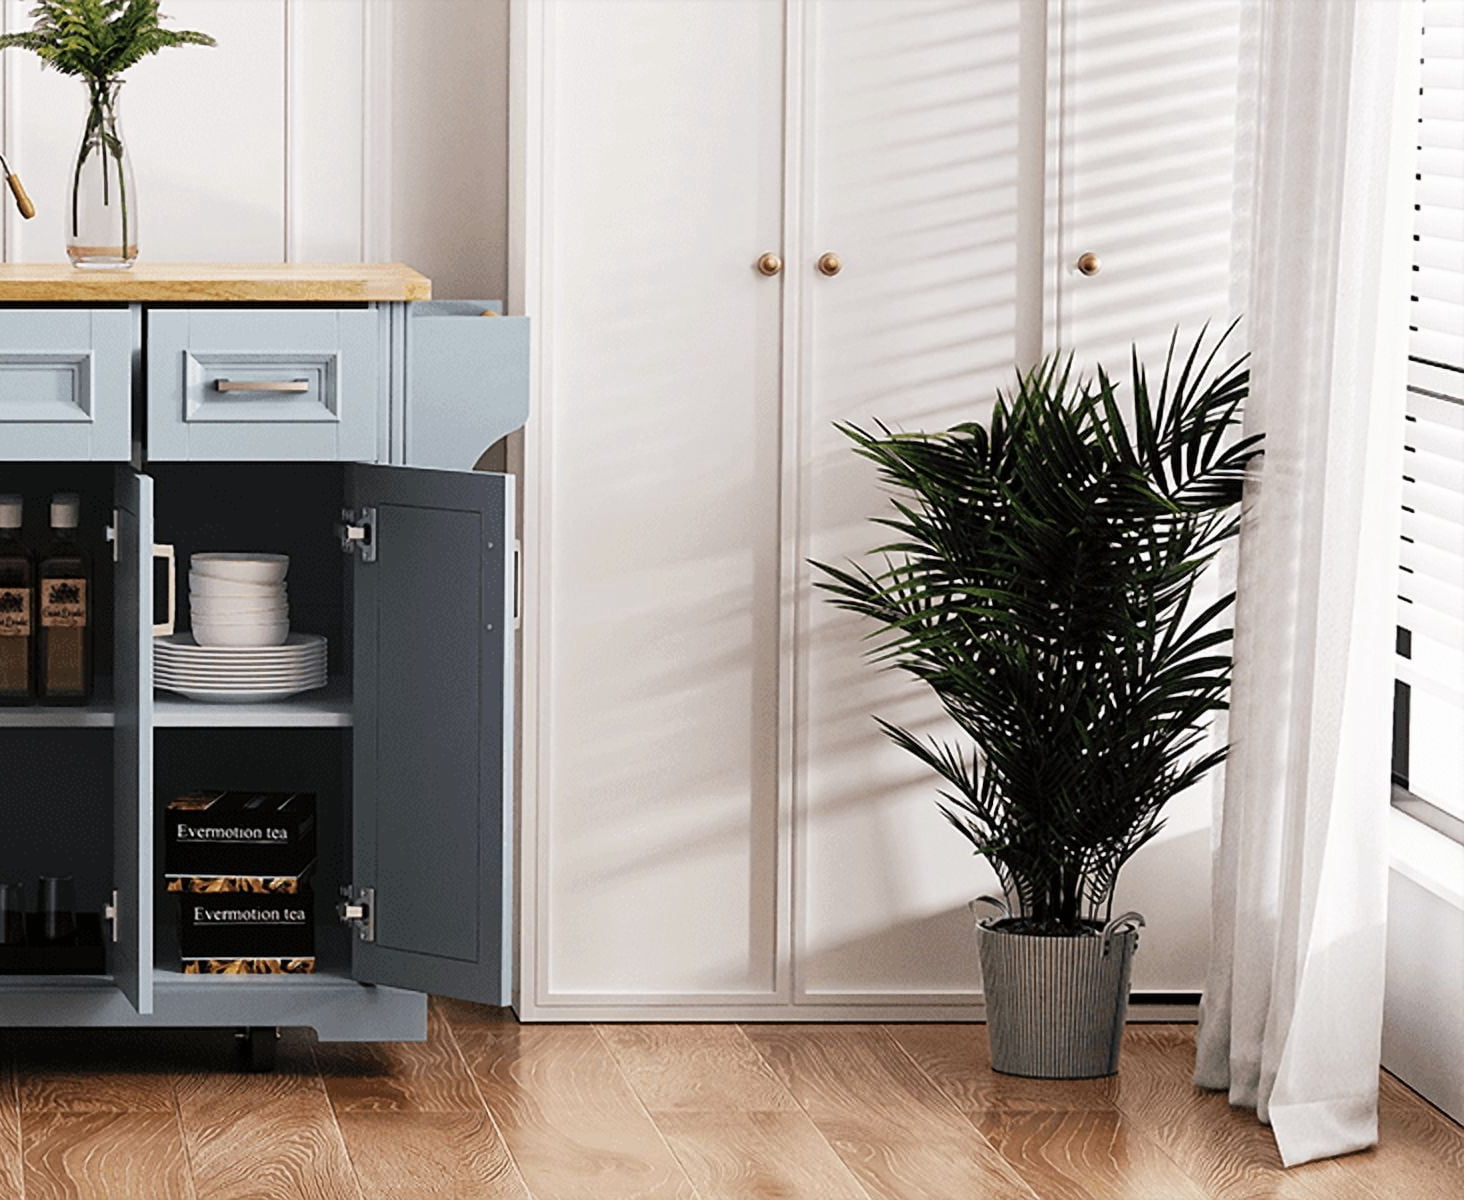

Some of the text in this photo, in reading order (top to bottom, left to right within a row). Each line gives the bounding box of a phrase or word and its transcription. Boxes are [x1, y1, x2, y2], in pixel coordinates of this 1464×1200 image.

[177, 823, 288, 839] Evermotion tea
[194, 906, 306, 921] Evermotion tea
